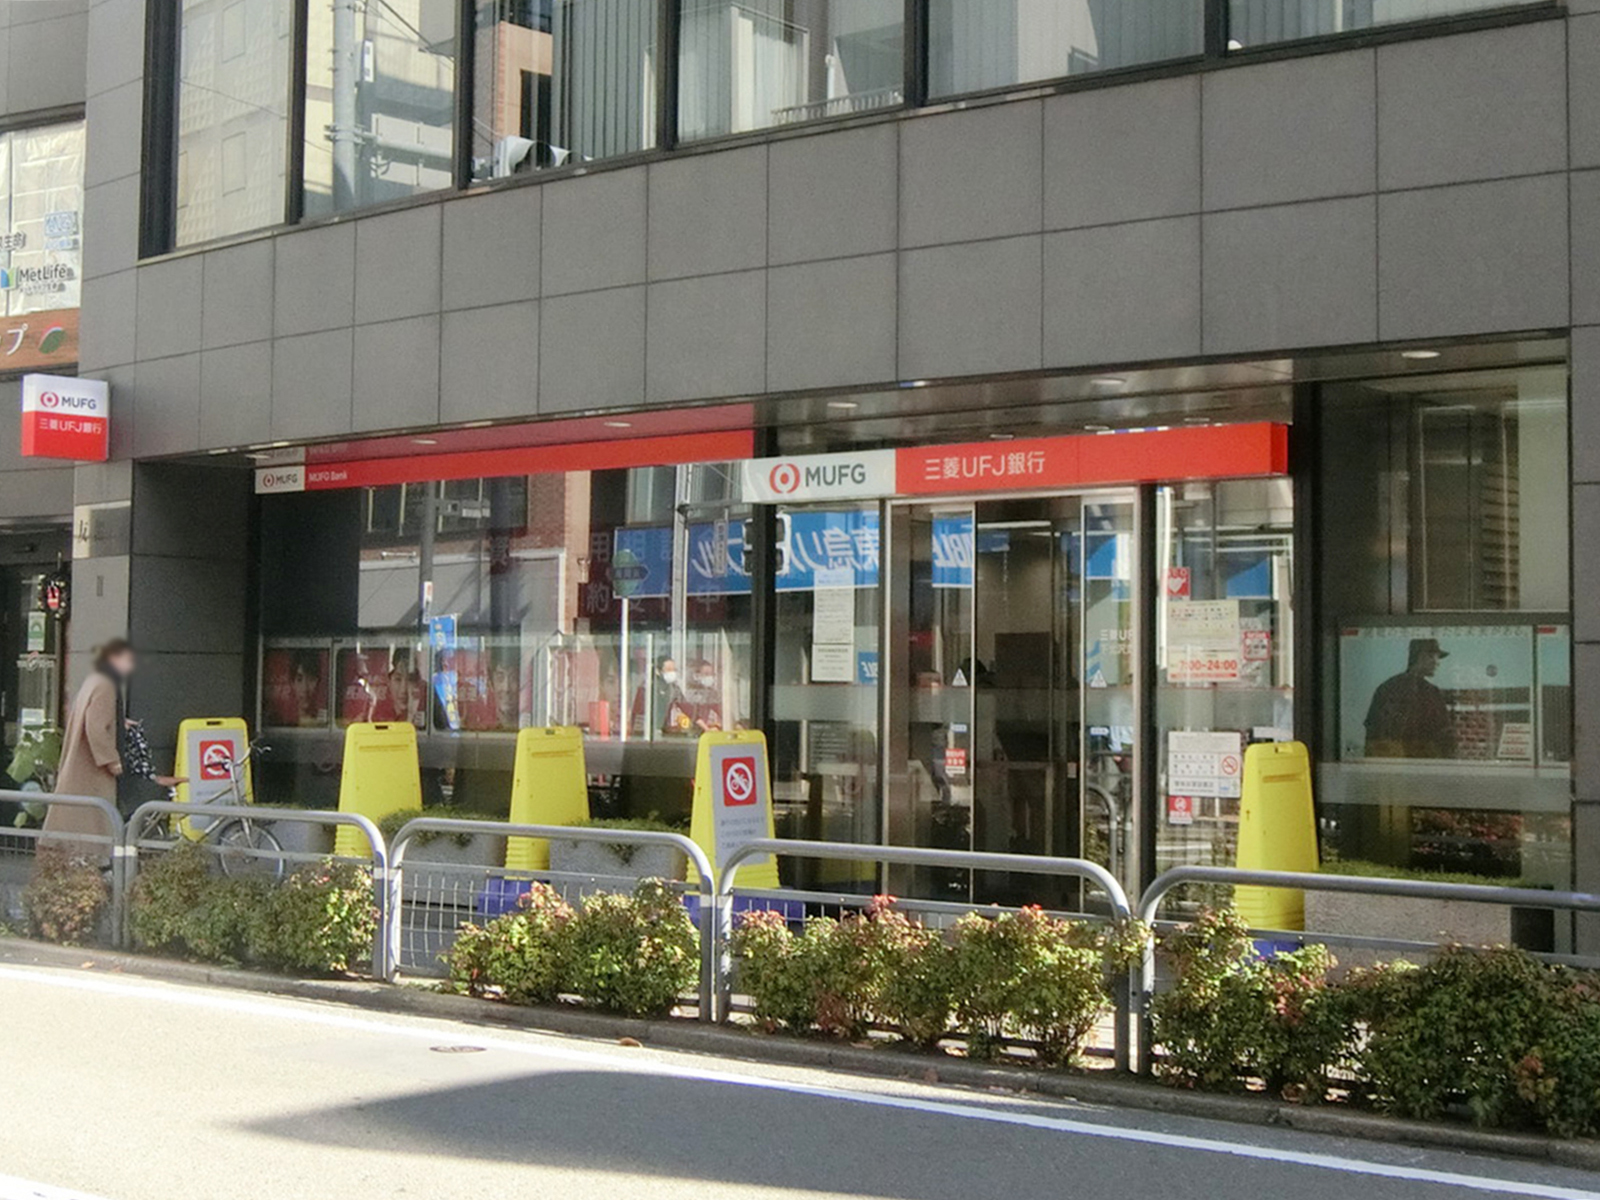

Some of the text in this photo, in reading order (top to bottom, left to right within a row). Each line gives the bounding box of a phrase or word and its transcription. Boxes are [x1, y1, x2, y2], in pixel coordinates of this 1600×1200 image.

[0, 231, 22, 249] 生命
[19, 263, 66, 282] MetLife
[0, 323, 28, 356] プ
[61, 395, 97, 410] MUFG
[39, 417, 102, 435] 三菱UFJ銀行
[805, 463, 866, 487] MUFG
[924, 451, 1046, 481] 三菱UFJ銀行
[275, 474, 298, 486] MUFG
